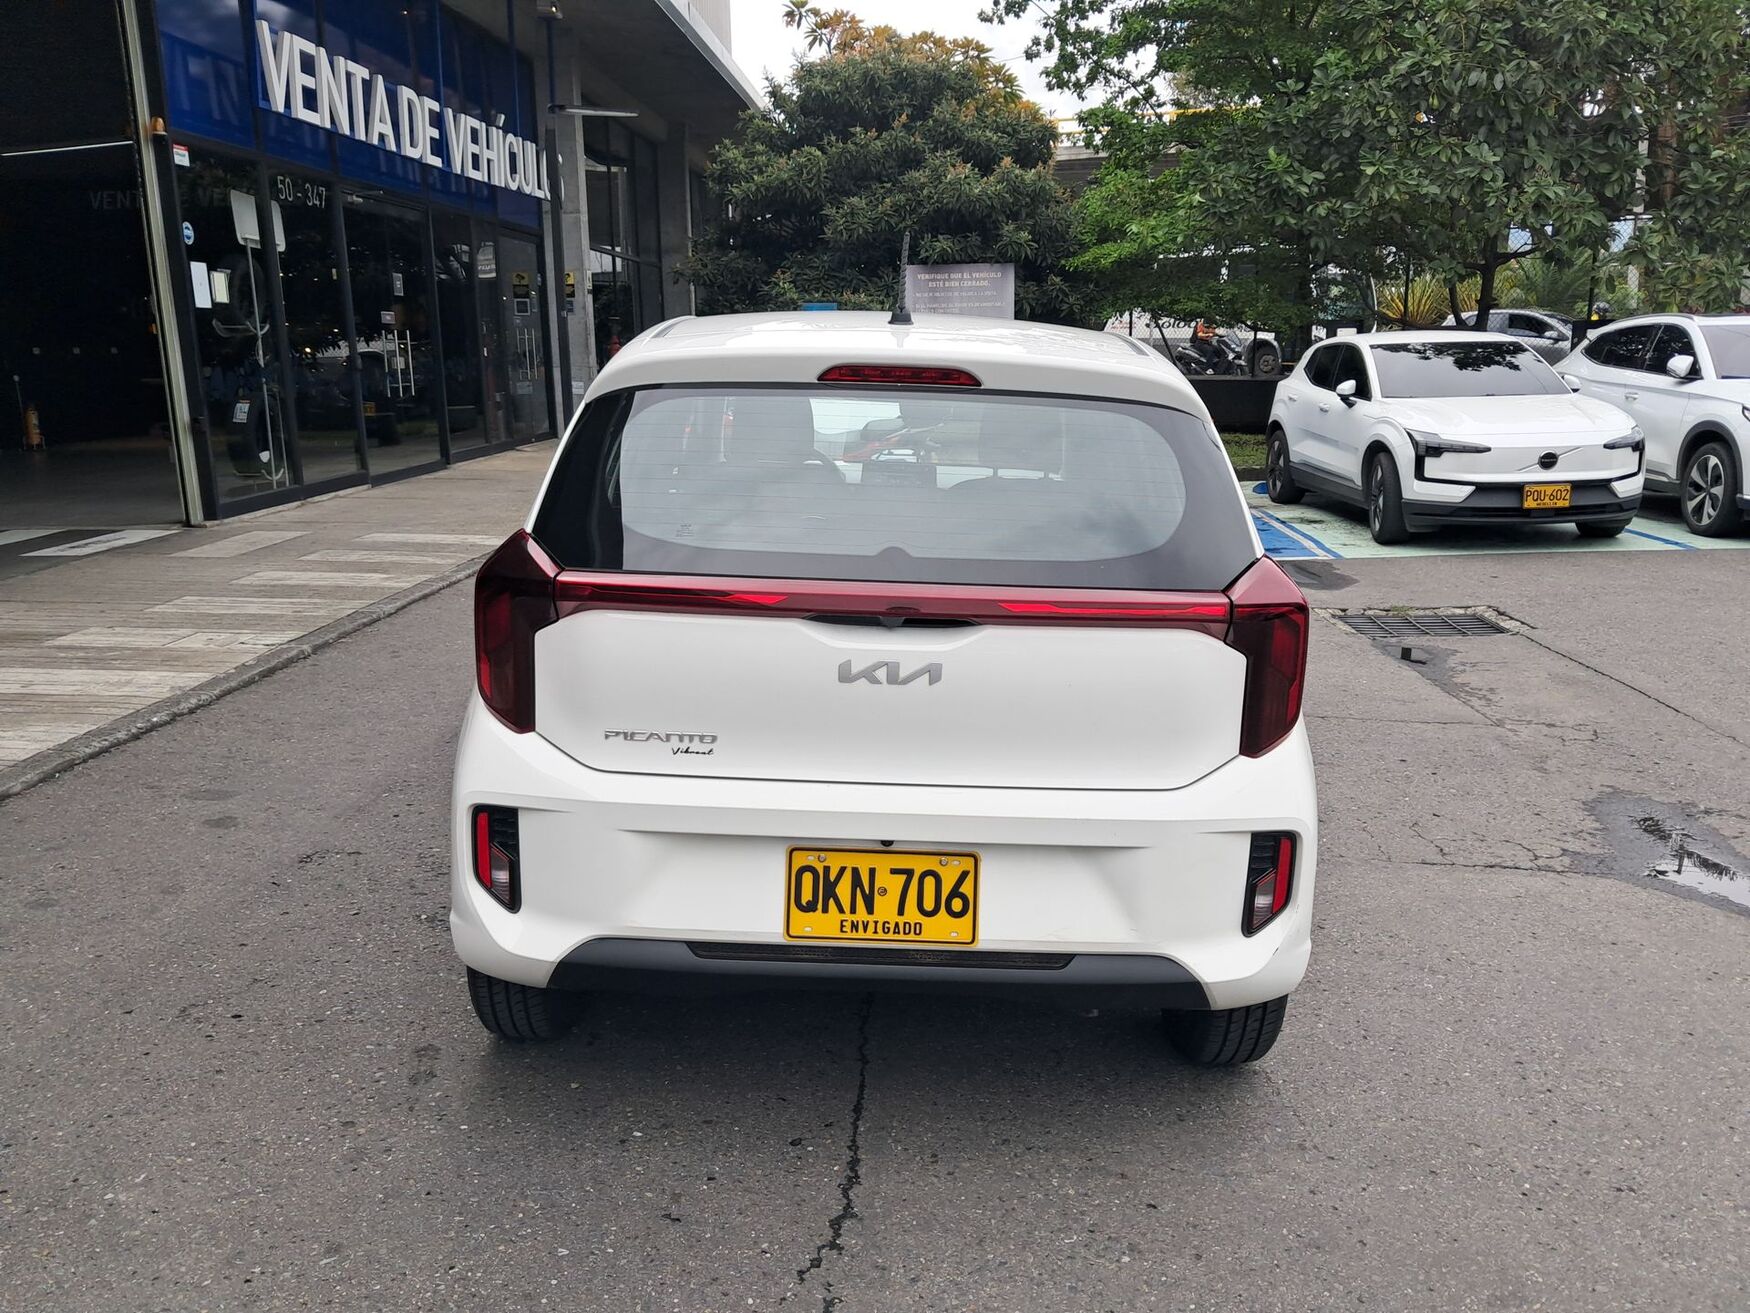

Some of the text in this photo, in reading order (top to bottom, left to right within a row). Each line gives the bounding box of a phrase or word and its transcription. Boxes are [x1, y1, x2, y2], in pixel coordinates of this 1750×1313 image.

[255, 19, 397, 152] VENTA
[397, 85, 442, 168] DE
[277, 176, 293, 201] 50
[305, 184, 326, 208] 347
[838, 659, 943, 686] KIA
[604, 728, 718, 745] PICANTO
[672, 746, 714, 756] Vibrant
[839, 919, 923, 936] ENVIGADO
